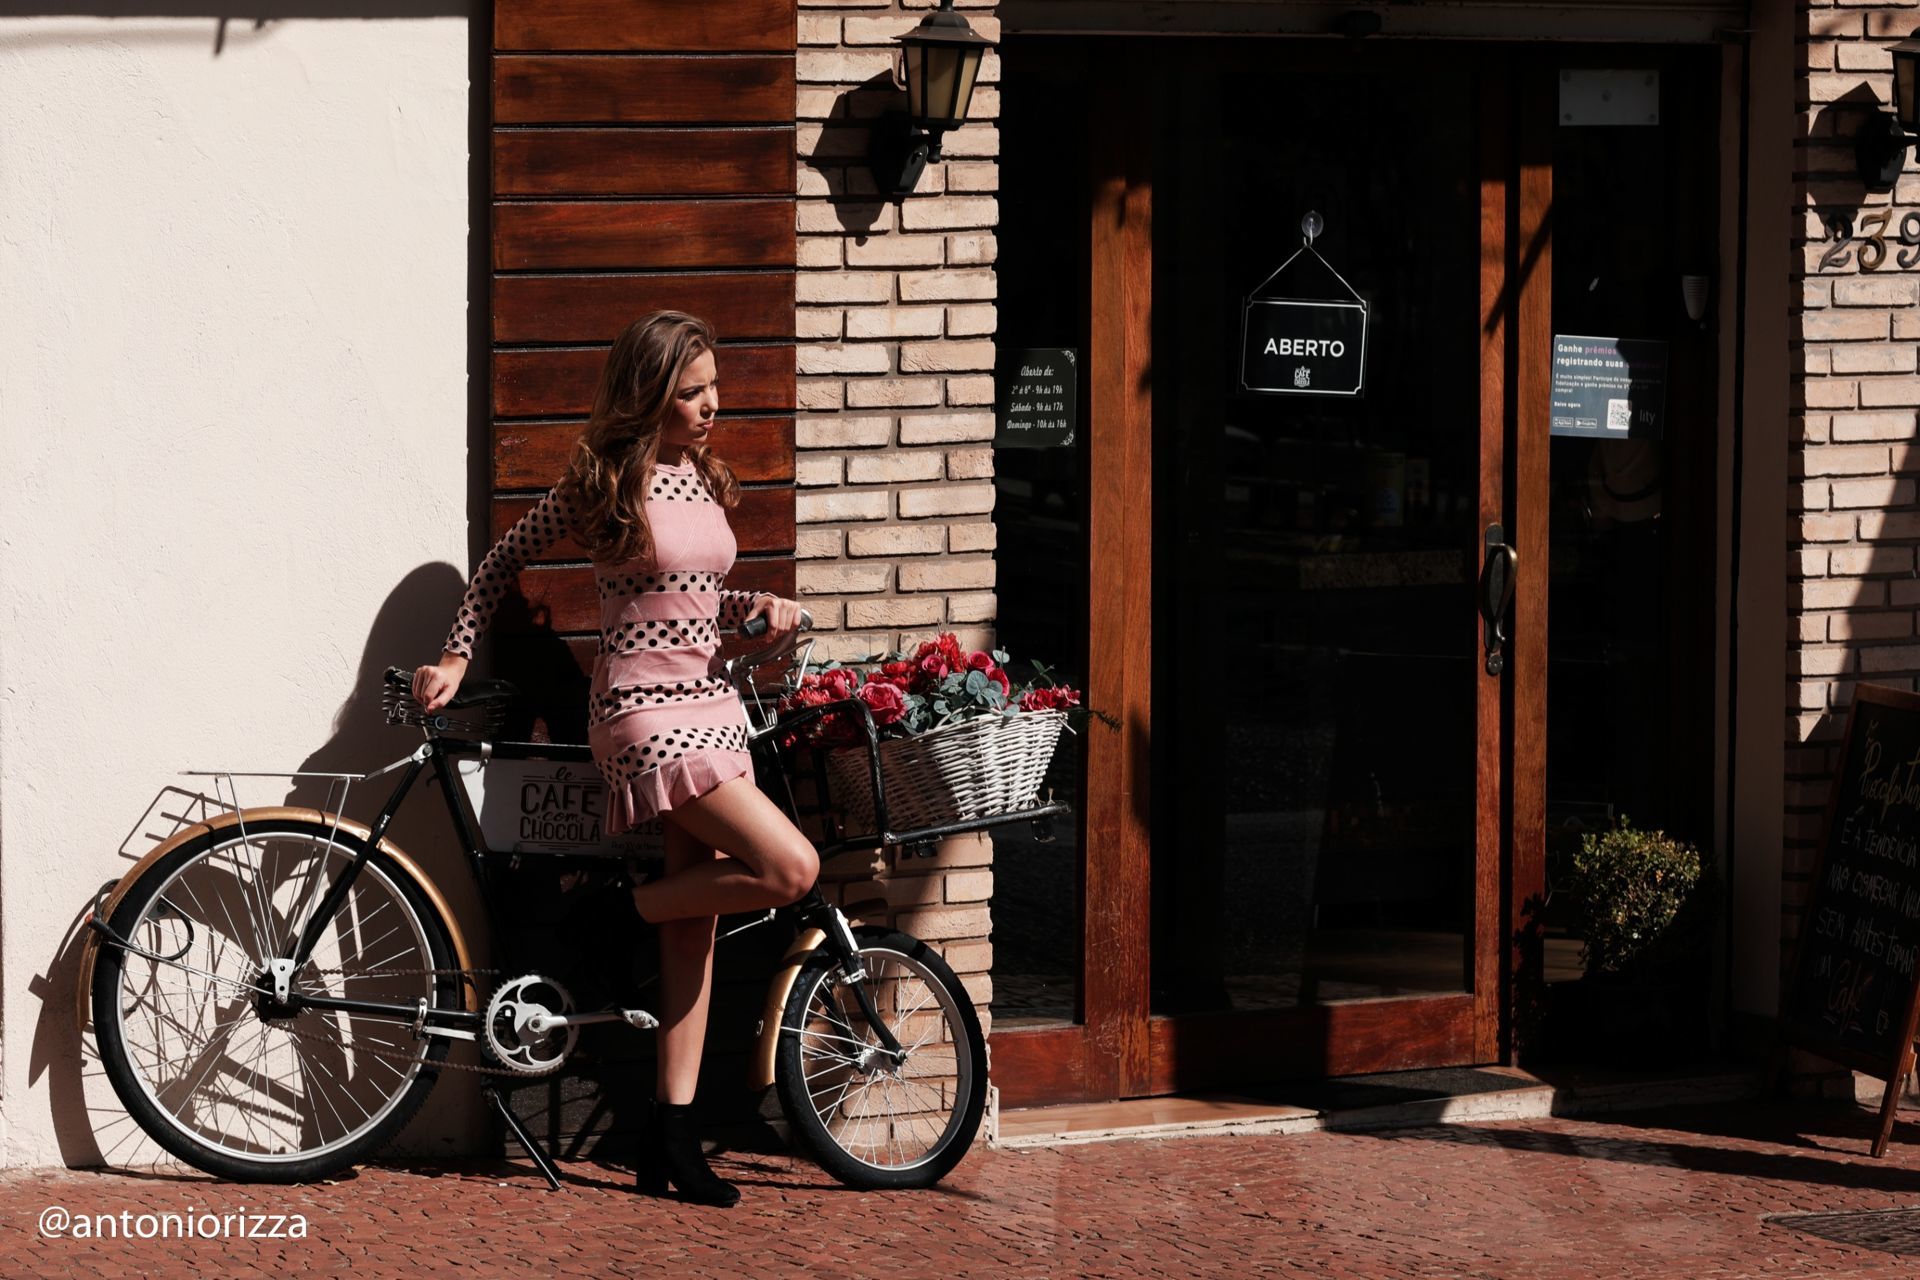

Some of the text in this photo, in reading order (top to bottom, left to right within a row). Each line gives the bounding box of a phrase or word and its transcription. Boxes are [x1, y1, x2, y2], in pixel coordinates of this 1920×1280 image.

[1819, 208, 1920, 272] 239
[1264, 338, 1344, 358] ABERTO
[1558, 344, 1616, 356] Ganhe prêmios
[1556, 356, 1603, 367] registrando
[1020, 365, 1054, 376] Aberto de:
[1036, 385, 1043, 394] 9h
[1052, 385, 1063, 394] 19h
[1010, 402, 1031, 412] Sábado
[1036, 402, 1043, 411] 9h
[1053, 402, 1063, 411] 17h
[1006, 419, 1031, 431] Domingo
[1037, 419, 1047, 428] 10h
[1057, 419, 1066, 428] 16h
[550, 766, 576, 780] le
[542, 811, 580, 823] com
[520, 816, 601, 842] CHOCOLÁ
[1816, 906, 1845, 943] SEM
